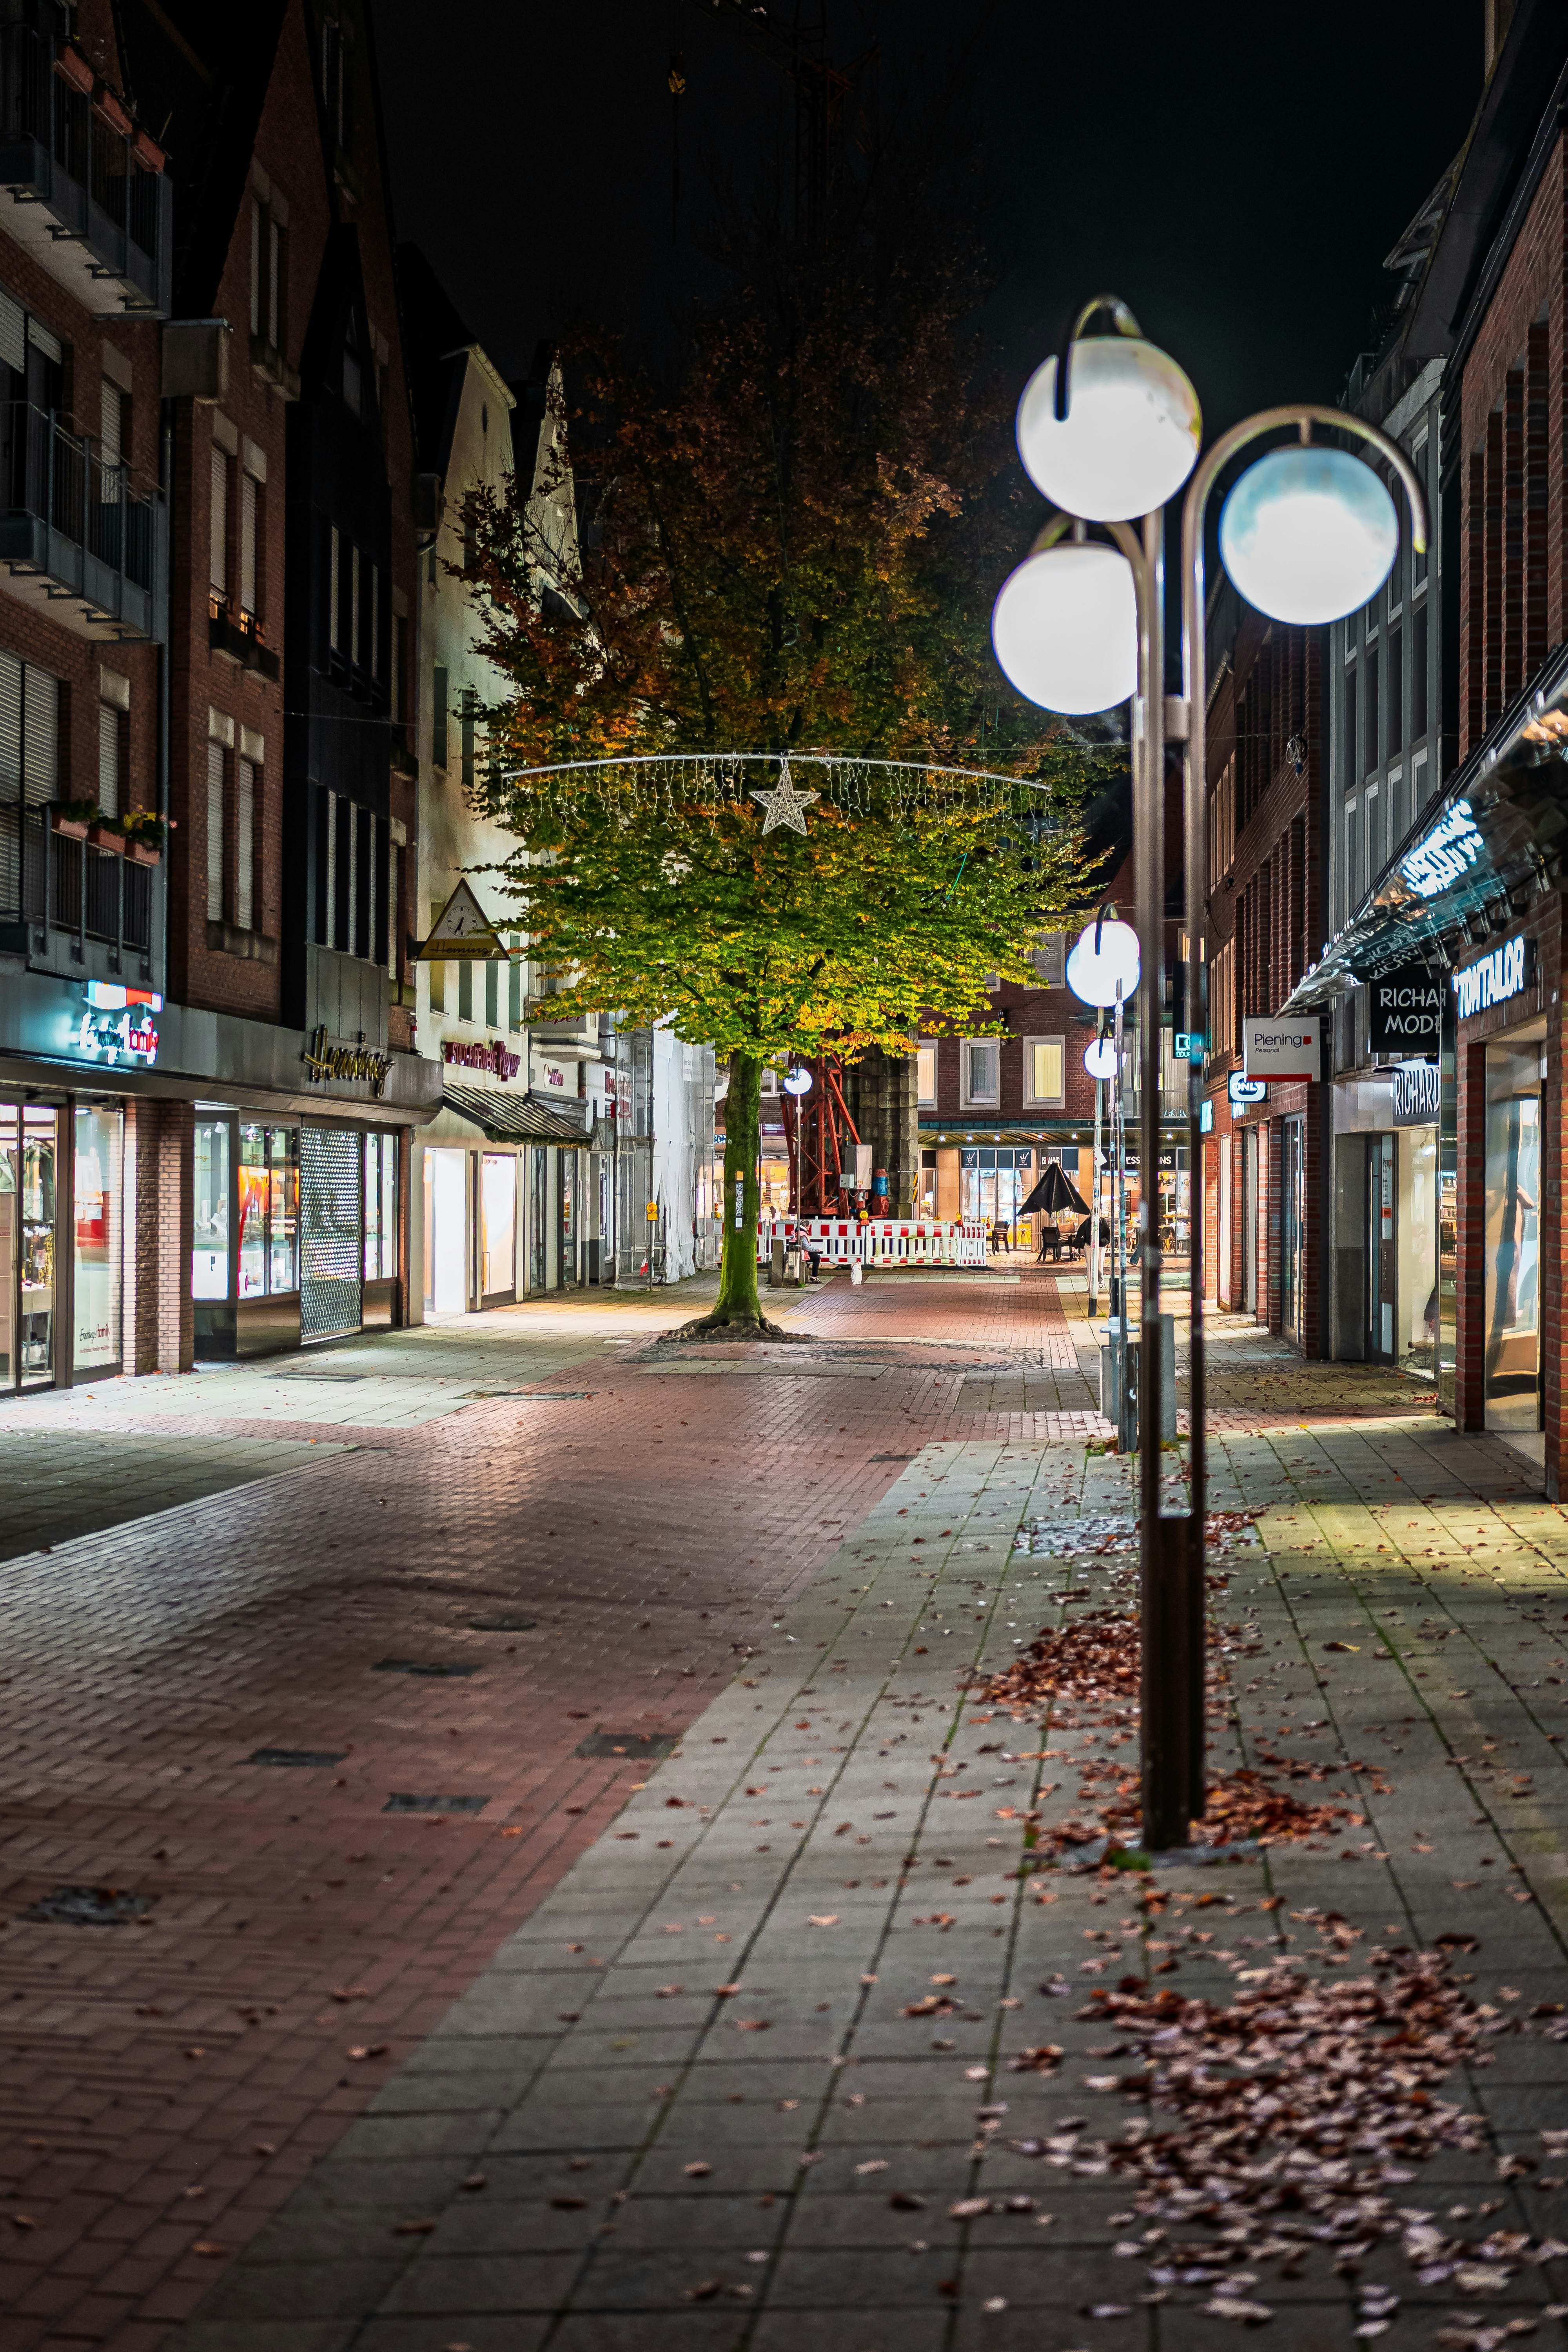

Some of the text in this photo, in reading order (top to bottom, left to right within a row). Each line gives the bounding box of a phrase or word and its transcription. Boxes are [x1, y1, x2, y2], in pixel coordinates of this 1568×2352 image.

[429, 941, 492, 957] Heming
[1254, 1033, 1302, 1048] Piening
[1232, 1082, 1263, 1091] ONLY
[1395, 1067, 1441, 1116] RICHARD
